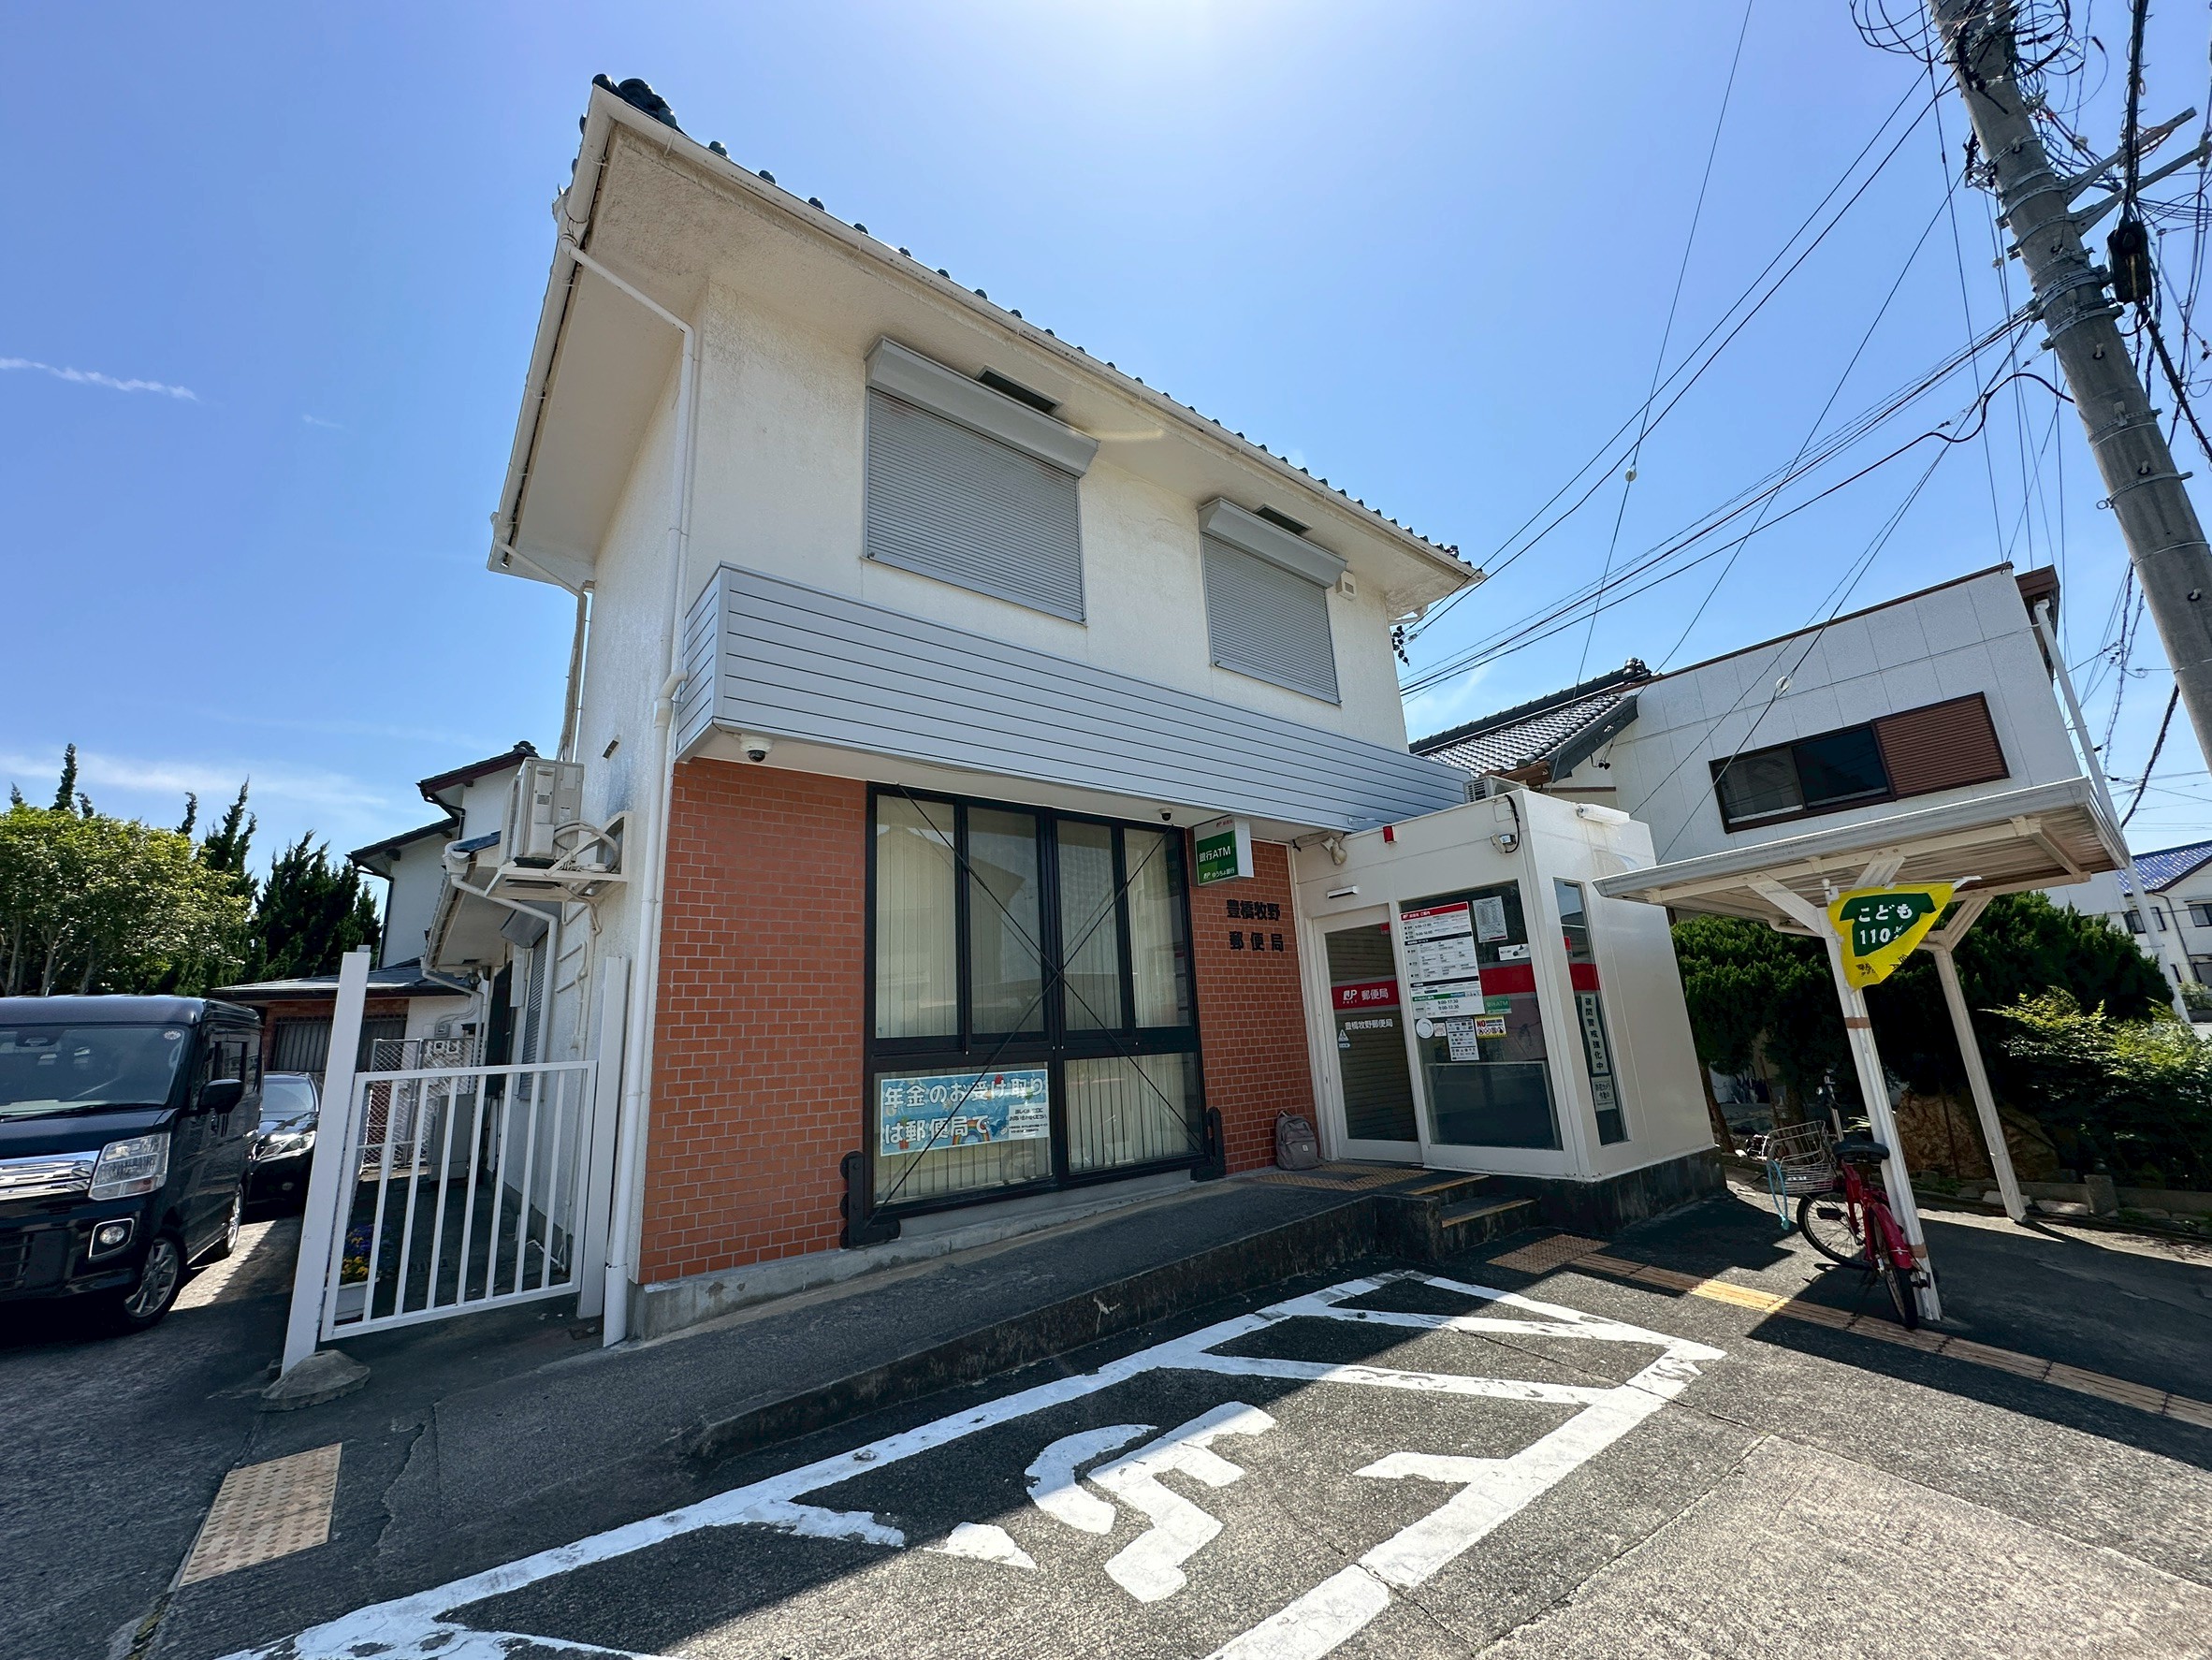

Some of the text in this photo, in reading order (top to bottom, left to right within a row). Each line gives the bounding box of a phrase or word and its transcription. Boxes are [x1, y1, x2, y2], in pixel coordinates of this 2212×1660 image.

[1199, 845, 1231, 863] 銀行ATM
[1211, 866, 1235, 879] ゆうちょ銀行
[1226, 899, 1281, 922] 豊橋牧野
[1858, 903, 1913, 923] こども
[1229, 931, 1285, 953] 郵便局
[1361, 987, 1389, 1000] 郵便局
[1345, 1018, 1393, 1030] 豊橋牧野郵便局
[883, 1077, 1044, 1109] 年金のお受け取り
[884, 1114, 991, 1145] は郵便局で
